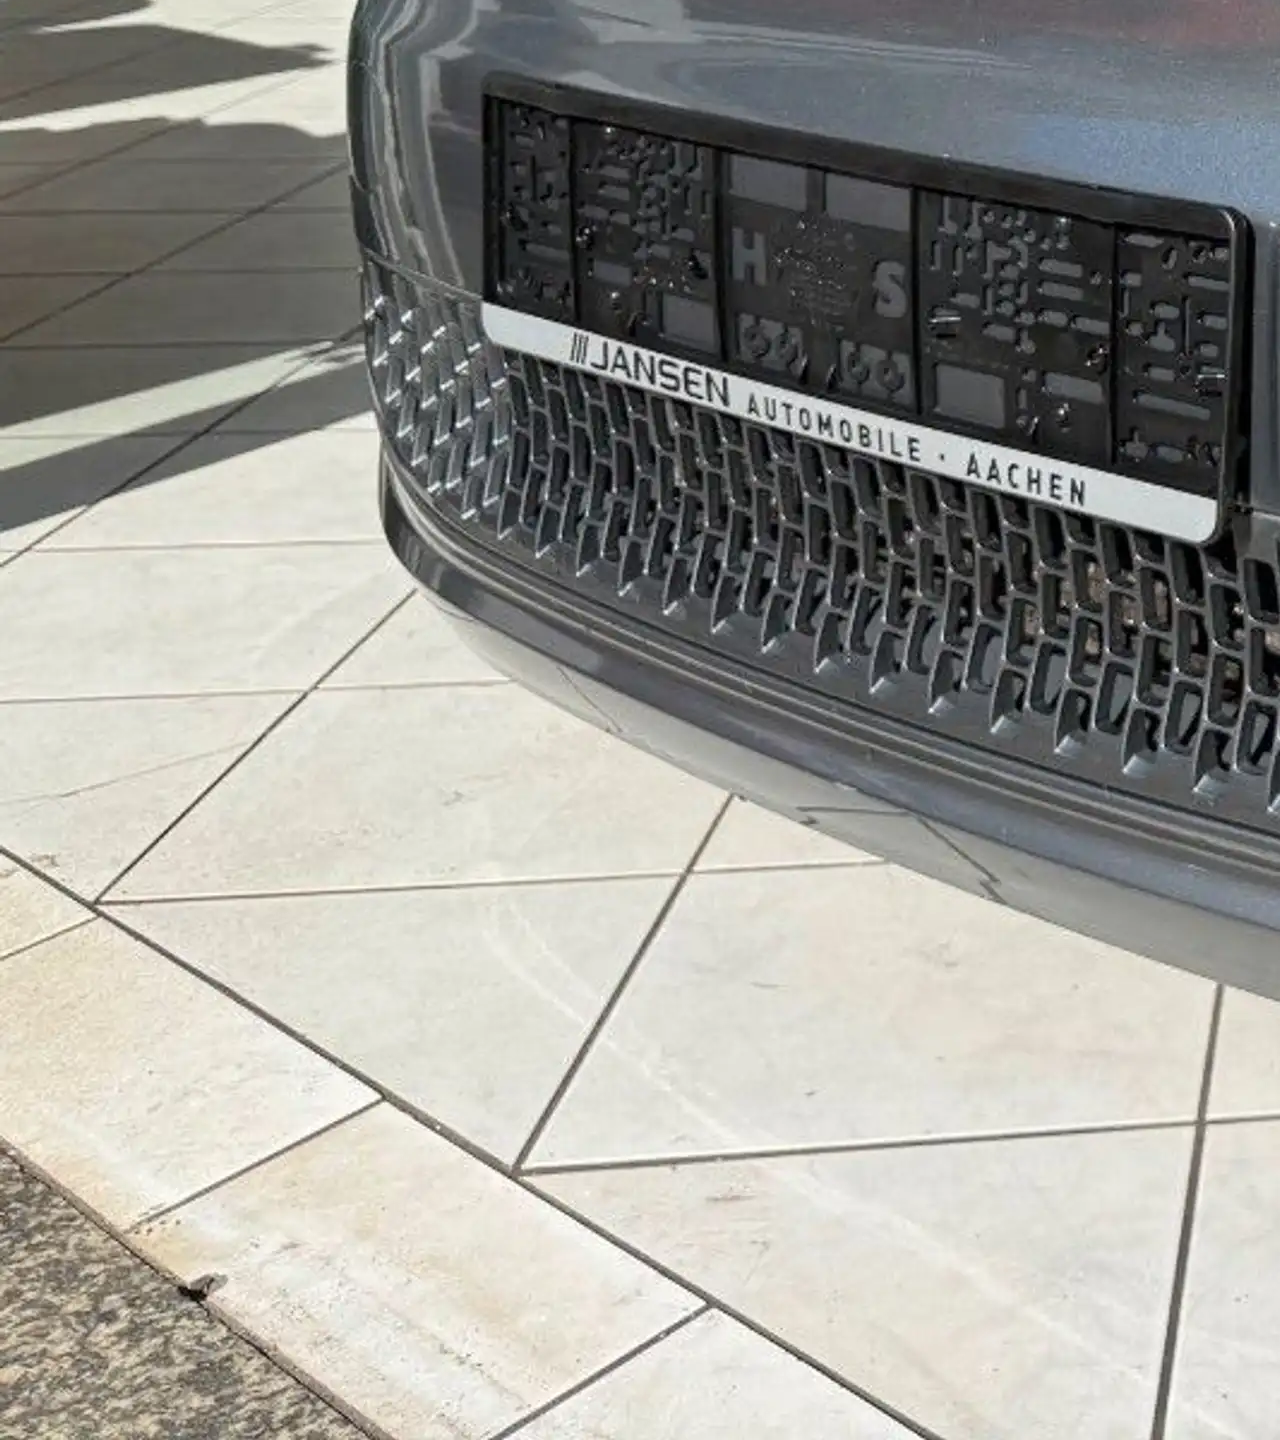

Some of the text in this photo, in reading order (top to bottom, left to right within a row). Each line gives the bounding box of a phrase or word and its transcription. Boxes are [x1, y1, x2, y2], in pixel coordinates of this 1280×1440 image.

[590, 341, 731, 408] JANSEN
[748, 392, 922, 462] AUTOMOBILE
[966, 453, 1087, 507] AACHEN
